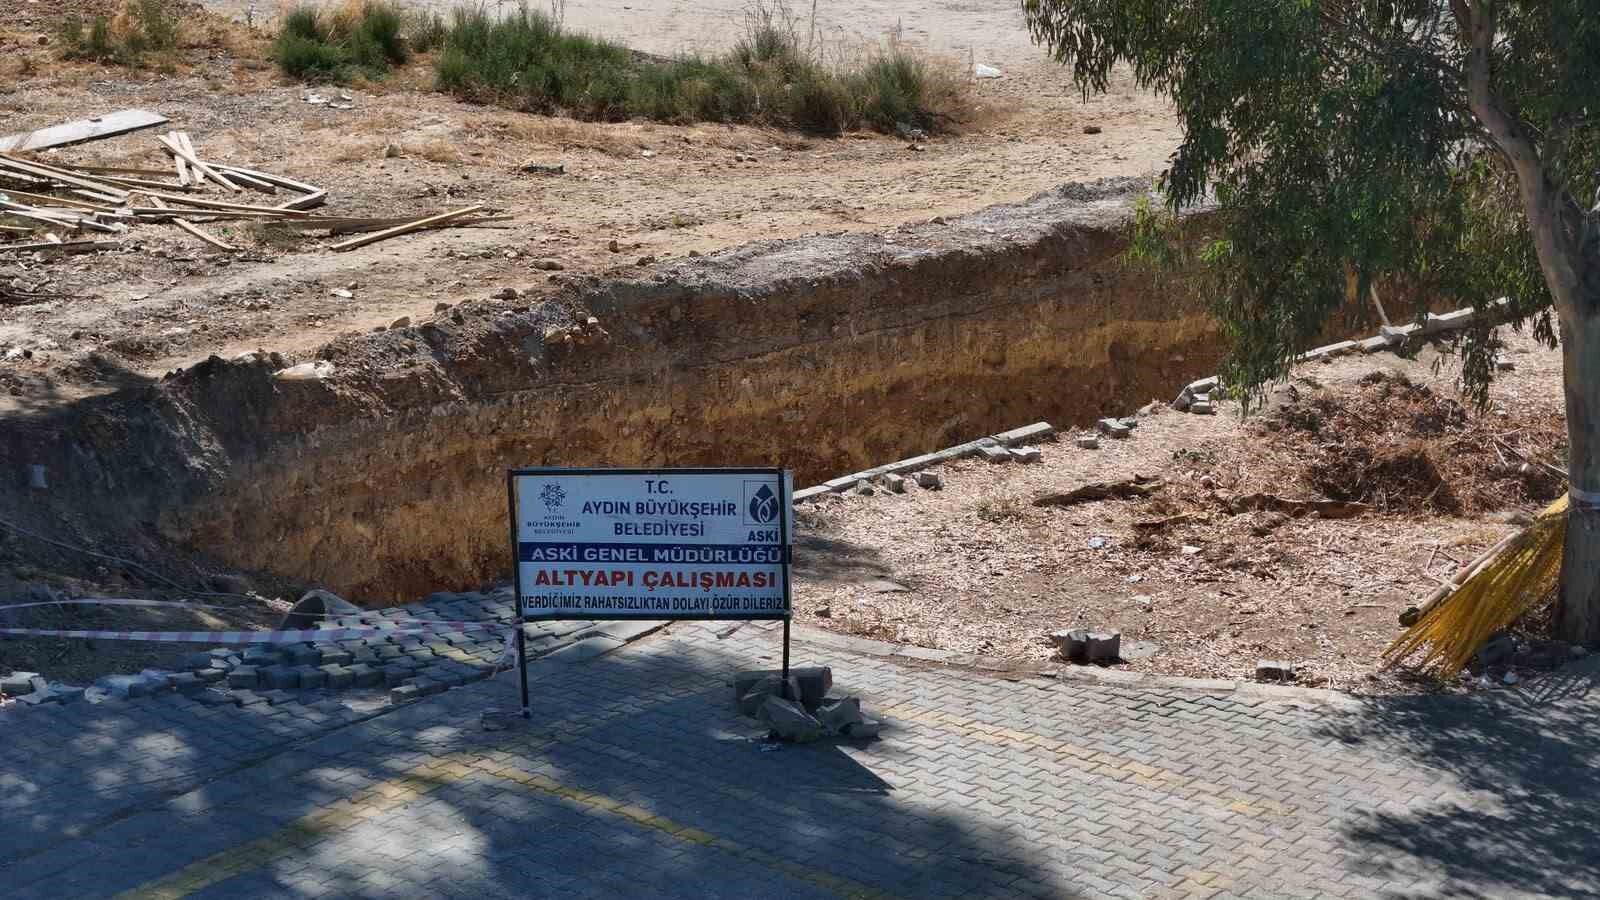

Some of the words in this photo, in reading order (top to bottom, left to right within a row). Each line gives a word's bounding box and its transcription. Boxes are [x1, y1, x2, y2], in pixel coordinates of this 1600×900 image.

[645, 480, 673, 494] T.C.
[582, 501, 630, 514] AYDIN
[635, 499, 737, 518] BÜYÜKŞEHİR
[614, 520, 704, 536] BELEDİYESİ
[747, 528, 779, 541] ASKİ
[531, 545, 577, 560] ASKİ
[584, 548, 649, 561] GENEL
[654, 547, 780, 562] MÜDÜRLÜĞÜ
[535, 570, 633, 586] ALTYAPI
[643, 571, 776, 592] ÇALIŞMASI
[584, 596, 670, 609] RAHATSIZLIKTAN
[713, 594, 741, 609] ÖZÜR
[744, 595, 781, 609] DİLERİZ
